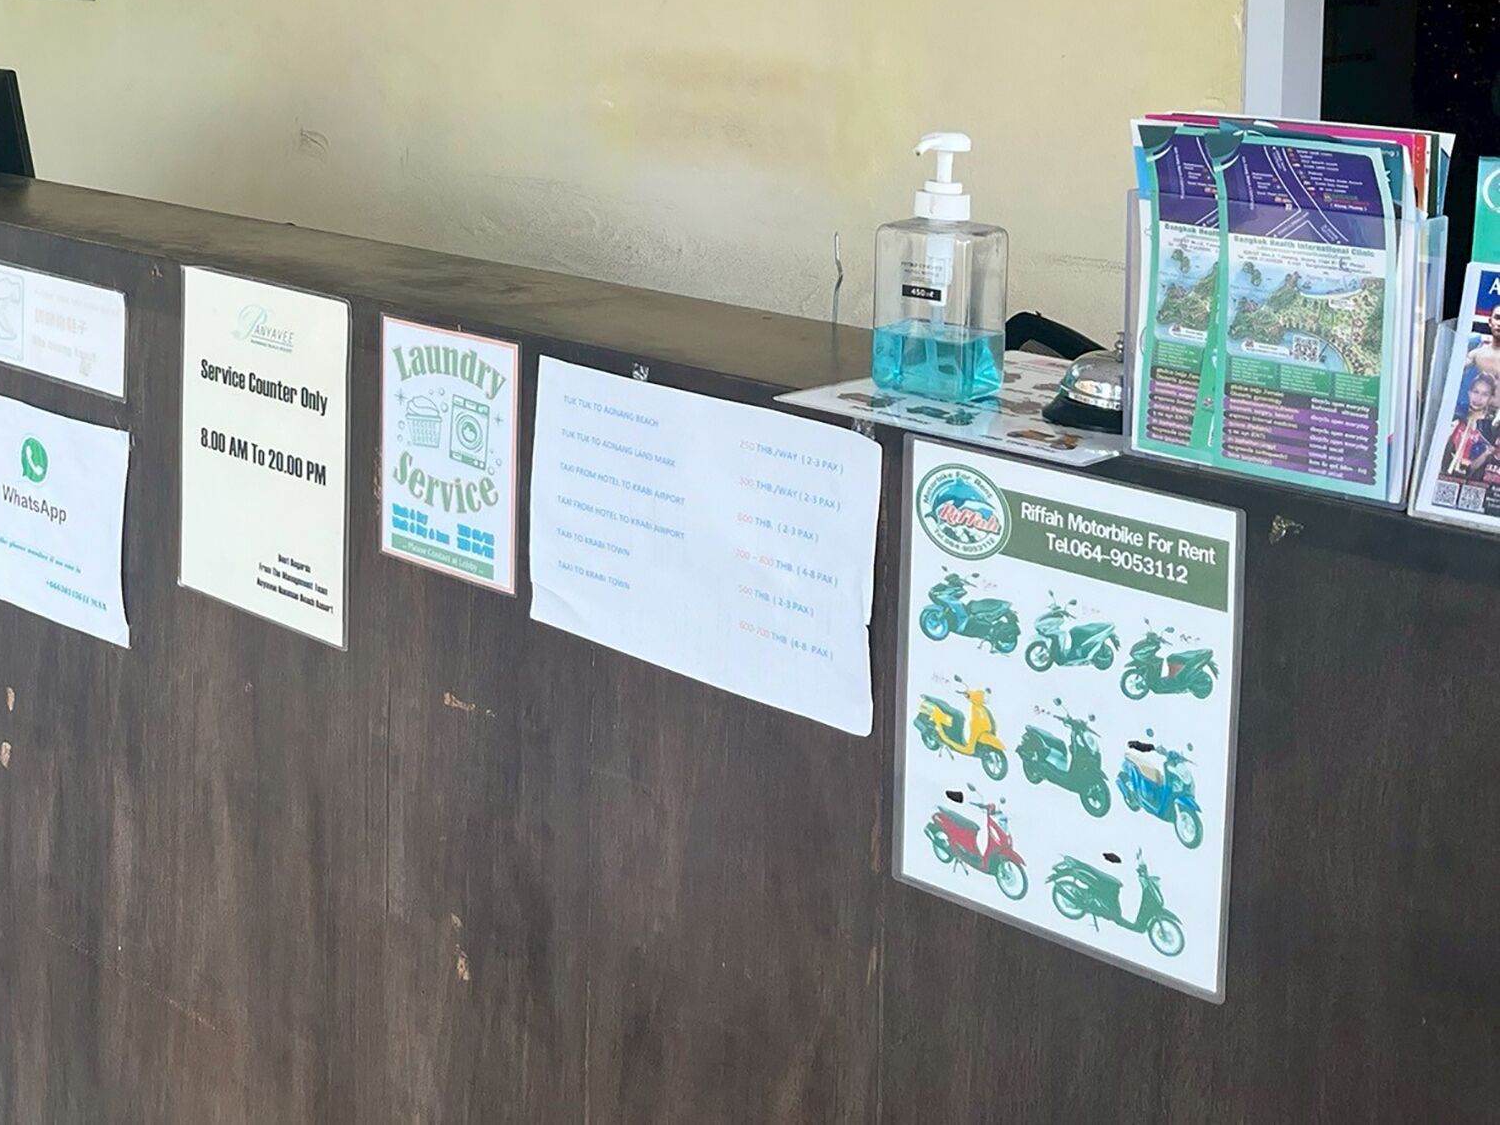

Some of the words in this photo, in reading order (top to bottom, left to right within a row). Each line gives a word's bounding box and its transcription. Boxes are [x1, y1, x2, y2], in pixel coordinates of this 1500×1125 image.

[1164, 223, 1197, 236] Bangkok
[1233, 234, 1268, 247] Bangkok
[1269, 237, 1295, 249] Health
[1297, 240, 1350, 255] International
[1351, 247, 1375, 258] Clinic
[391, 343, 507, 401] Laundry
[200, 358, 246, 390] Service
[248, 372, 298, 404] Counter
[300, 386, 328, 417] Only
[636, 414, 659, 427] BEACH
[200, 427, 226, 453] 8.00
[229, 436, 249, 461] AM
[251, 442, 266, 466] To
[268, 448, 303, 478] 20.00
[306, 460, 327, 487] PM
[654, 454, 676, 467] MARK
[393, 450, 499, 514] Service
[597, 473, 621, 487] HOTEL
[621, 479, 632, 490] TO
[654, 489, 686, 507] AIRPORT
[923, 473, 953, 505] Motorbike
[955, 471, 971, 480] For
[974, 478, 993, 499] Rent
[2, 484, 68, 525] WhatsApp
[619, 513, 630, 524] TO
[574, 532, 584, 543] TO
[606, 542, 631, 556] TOWN
[1020, 501, 1064, 528] Riffah
[1067, 512, 1144, 547] Motorbike
[1148, 531, 1174, 554] For
[1178, 538, 1216, 565] Rent
[574, 565, 585, 576] TO
[608, 576, 631, 590] TOWN
[811, 645, 828, 658] PAX
